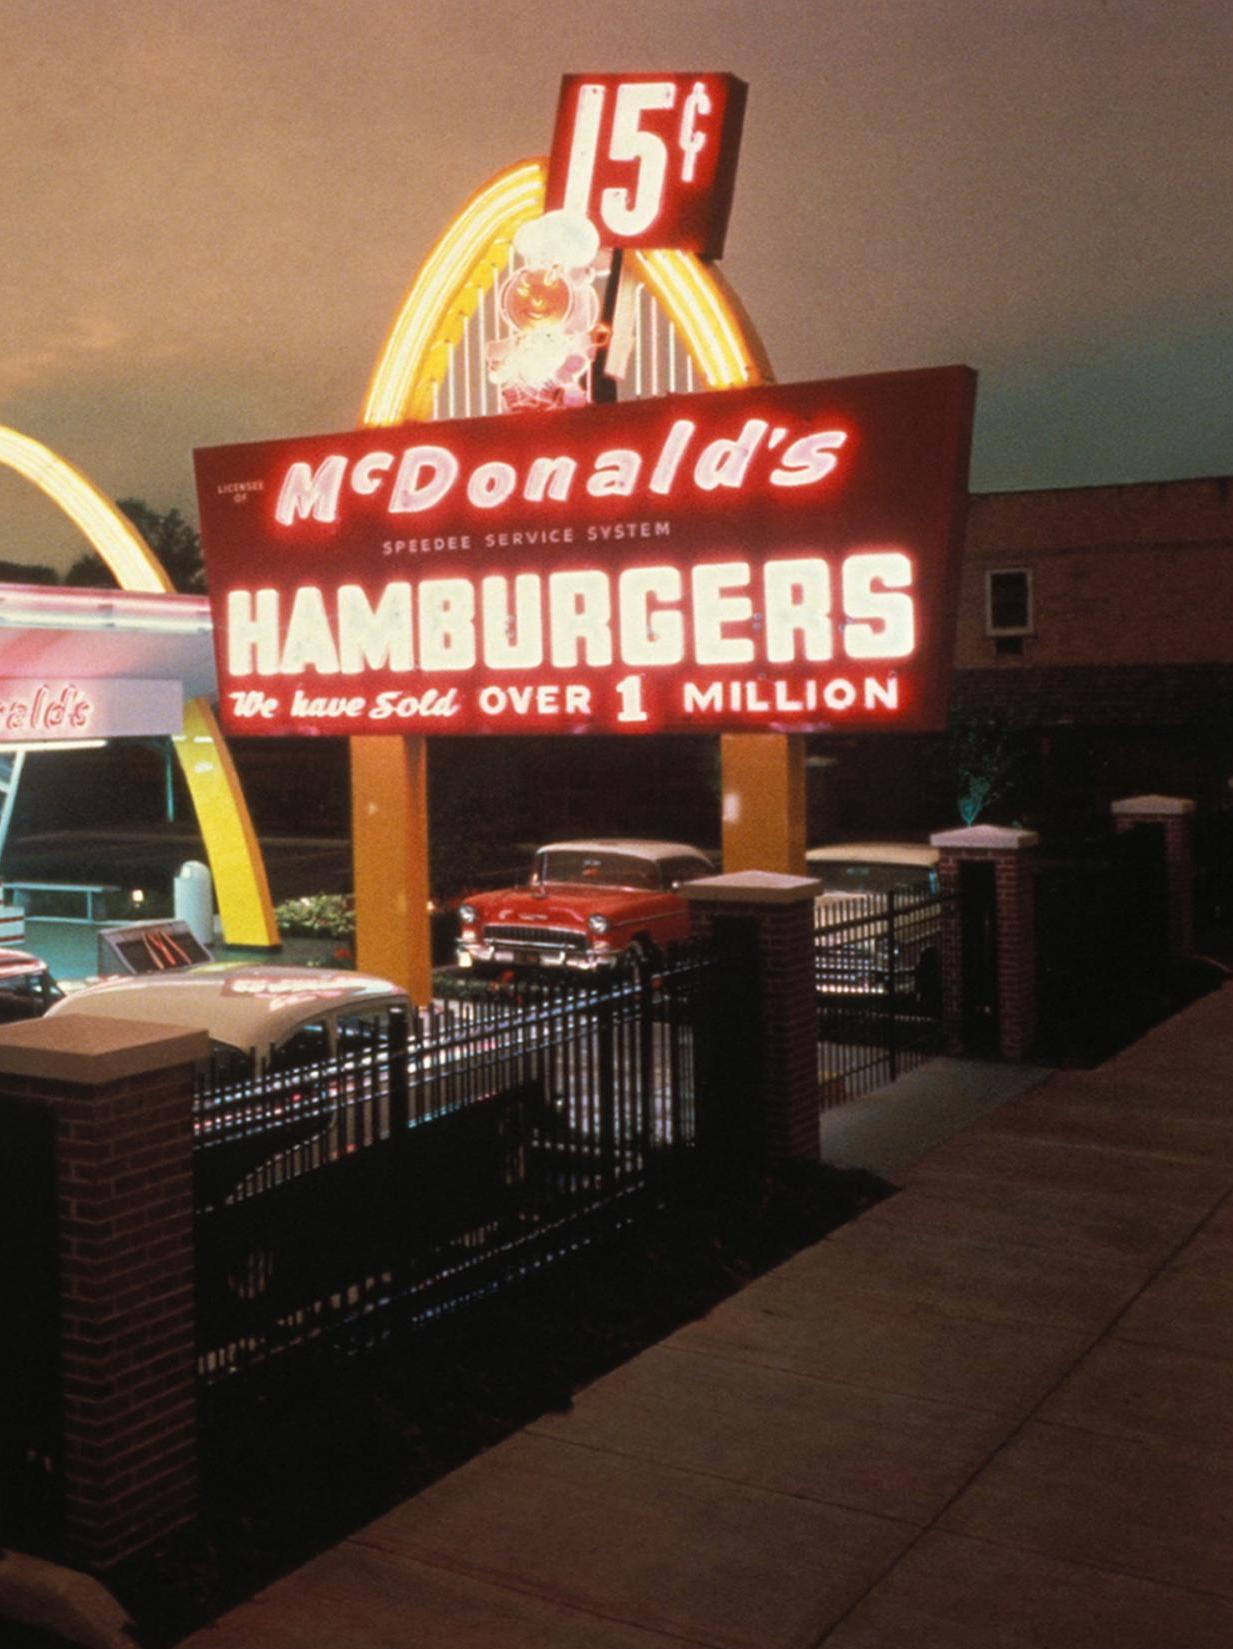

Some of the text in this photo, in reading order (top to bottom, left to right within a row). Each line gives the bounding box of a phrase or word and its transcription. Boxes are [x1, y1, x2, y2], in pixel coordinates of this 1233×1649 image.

[565, 82, 711, 236] 15¢
[217, 481, 264, 494] LICENSEE
[275, 419, 848, 526] McDonald's
[233, 493, 247, 503] OF
[382, 521, 671, 556] SPEEDEE SERVICE SYSTEM
[226, 552, 916, 677] HAMBURGERS
[228, 674, 899, 722] We have Sold OVER 1 MILLION
